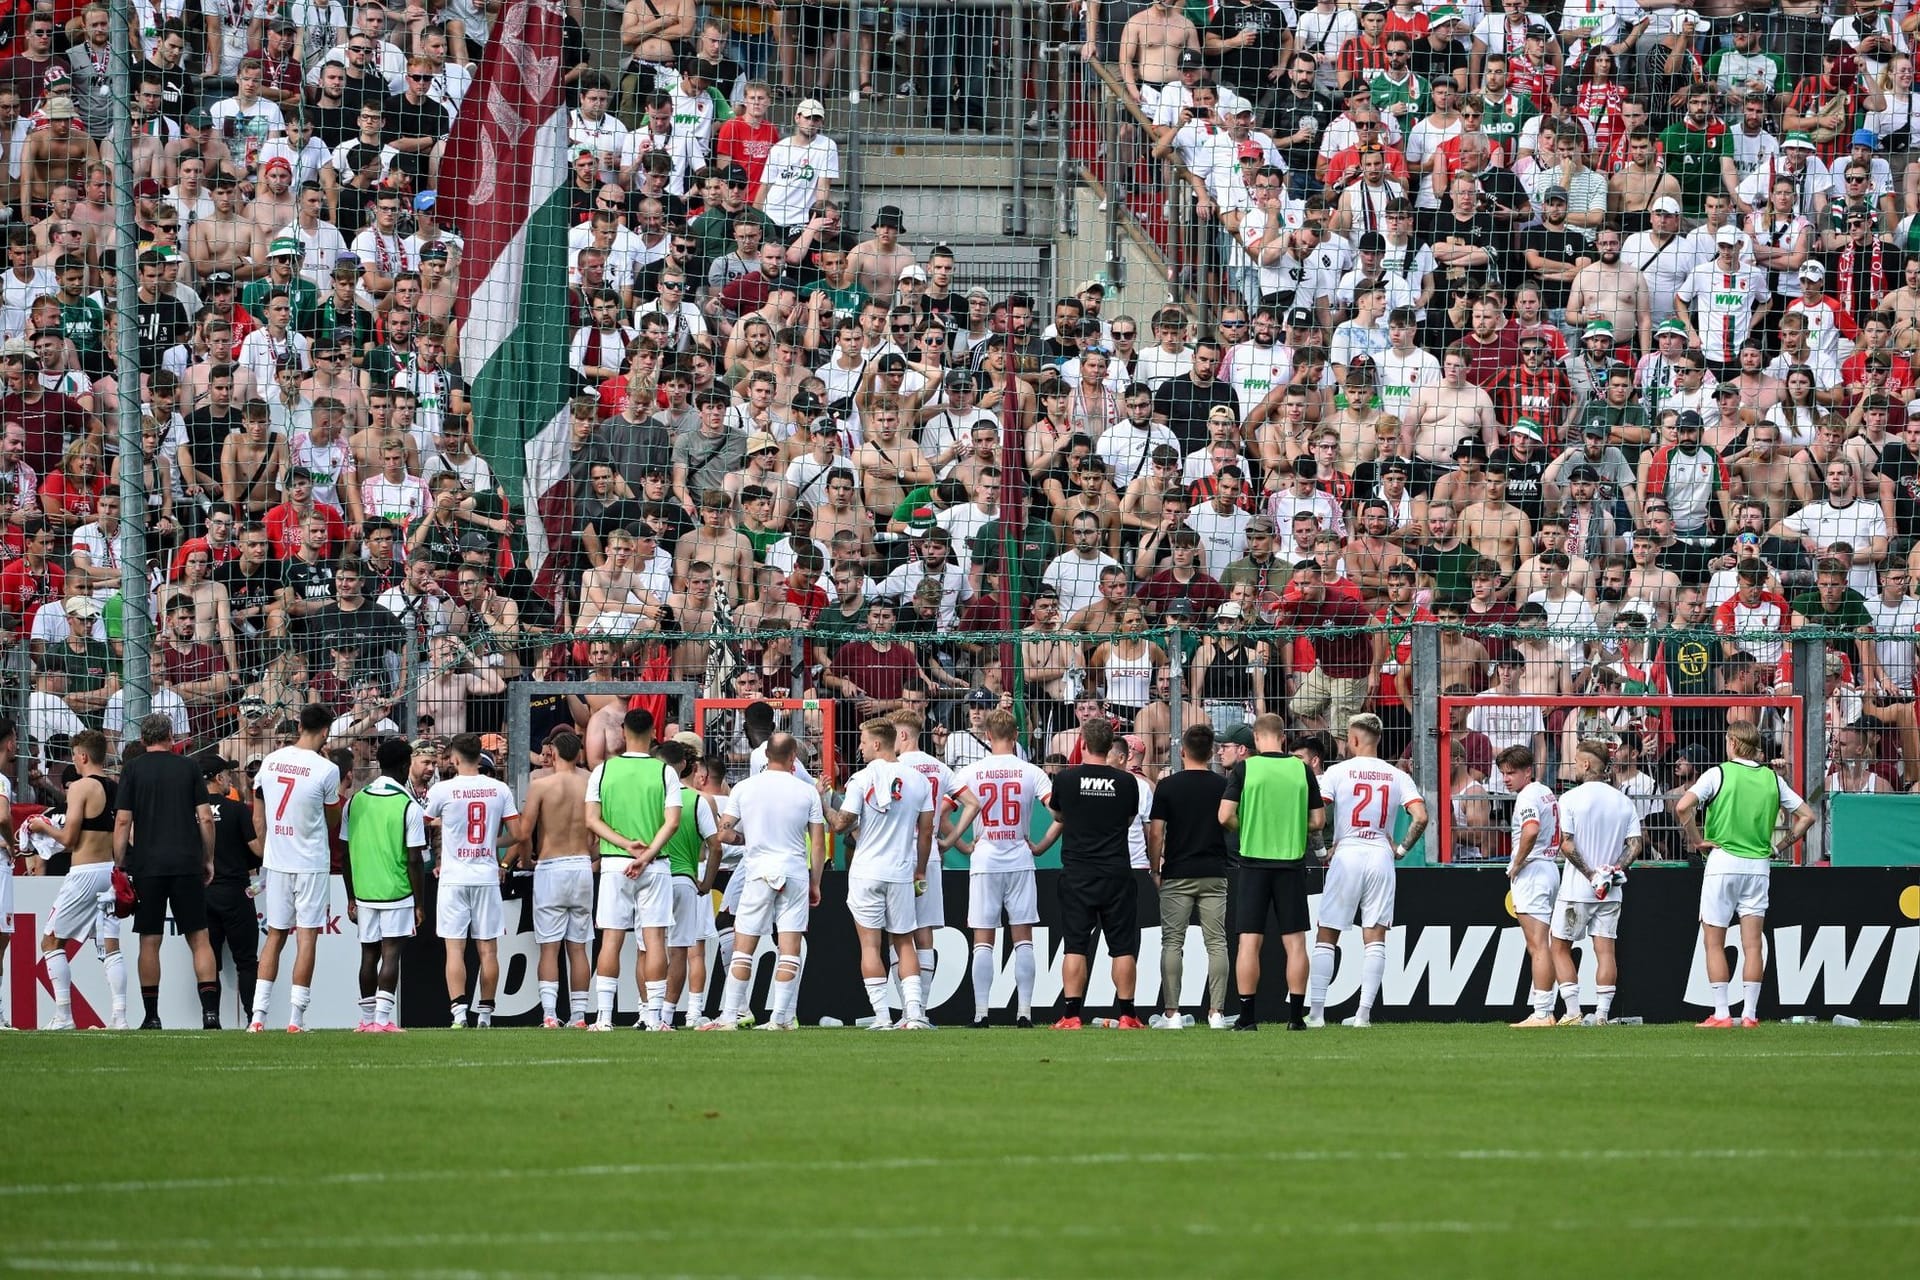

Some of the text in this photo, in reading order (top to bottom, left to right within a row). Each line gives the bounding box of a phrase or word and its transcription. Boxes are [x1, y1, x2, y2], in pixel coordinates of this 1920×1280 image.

[675, 114, 701, 125] WWK
[1715, 294, 1743, 305] WWK
[1243, 378, 1271, 390] WWK
[1384, 385, 1411, 396] WWK
[1520, 395, 1549, 408] WWK
[1508, 478, 1538, 491] WWK
[305, 584, 331, 596] WWK
[275, 763, 312, 777] AUGSBURG
[976, 768, 1023, 780] FC AUGSBURG
[1349, 769, 1394, 782] FC AUGSBURG
[1080, 777, 1115, 790] WWK
[277, 776, 296, 821] 7
[452, 788, 498, 800] FC AUGSBURG
[979, 782, 1021, 826] 26
[1351, 783, 1390, 829] 21
[467, 801, 486, 845] 8
[987, 831, 1017, 841] WINTHER
